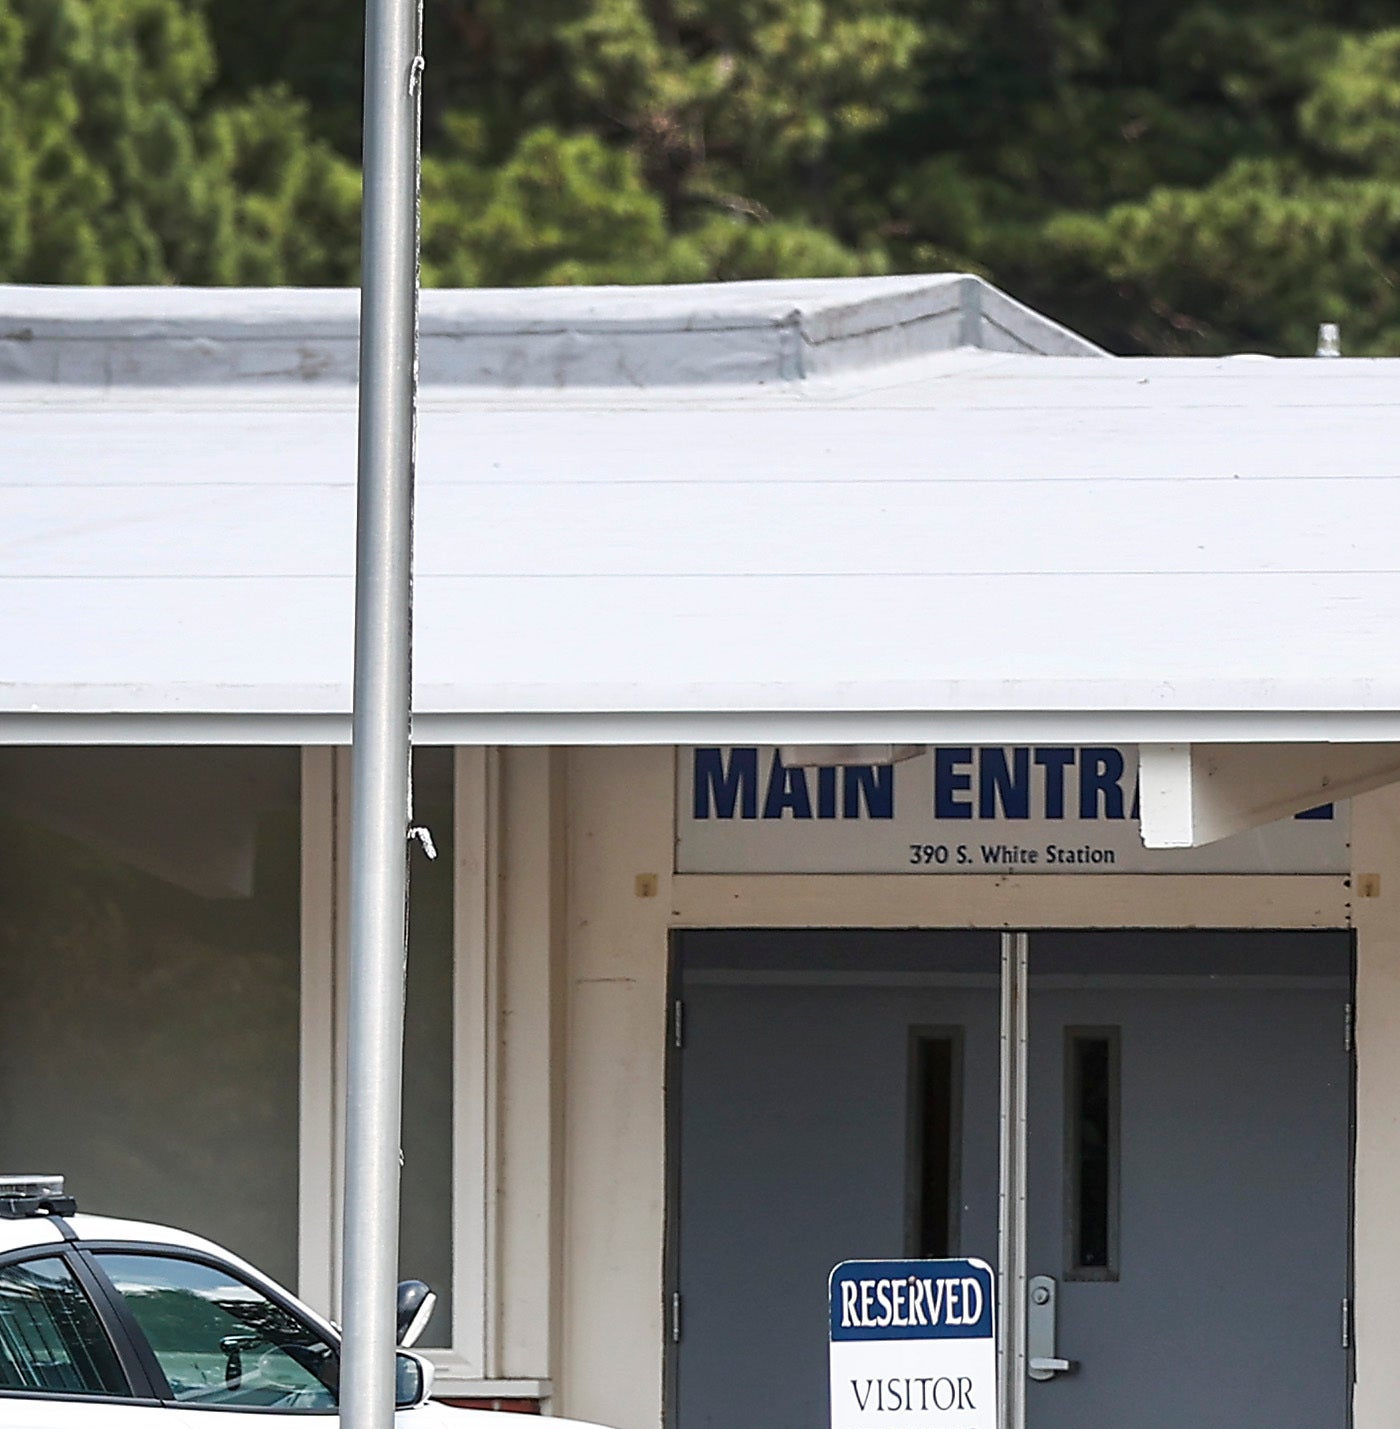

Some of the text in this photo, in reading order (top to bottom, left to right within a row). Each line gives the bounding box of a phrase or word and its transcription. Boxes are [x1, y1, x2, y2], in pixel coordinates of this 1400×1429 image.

[693, 748, 893, 819] MAIN
[909, 845, 1115, 864] 390 S. White Station
[840, 1277, 982, 1327] RESERVED
[850, 1377, 976, 1411] VISITOR
